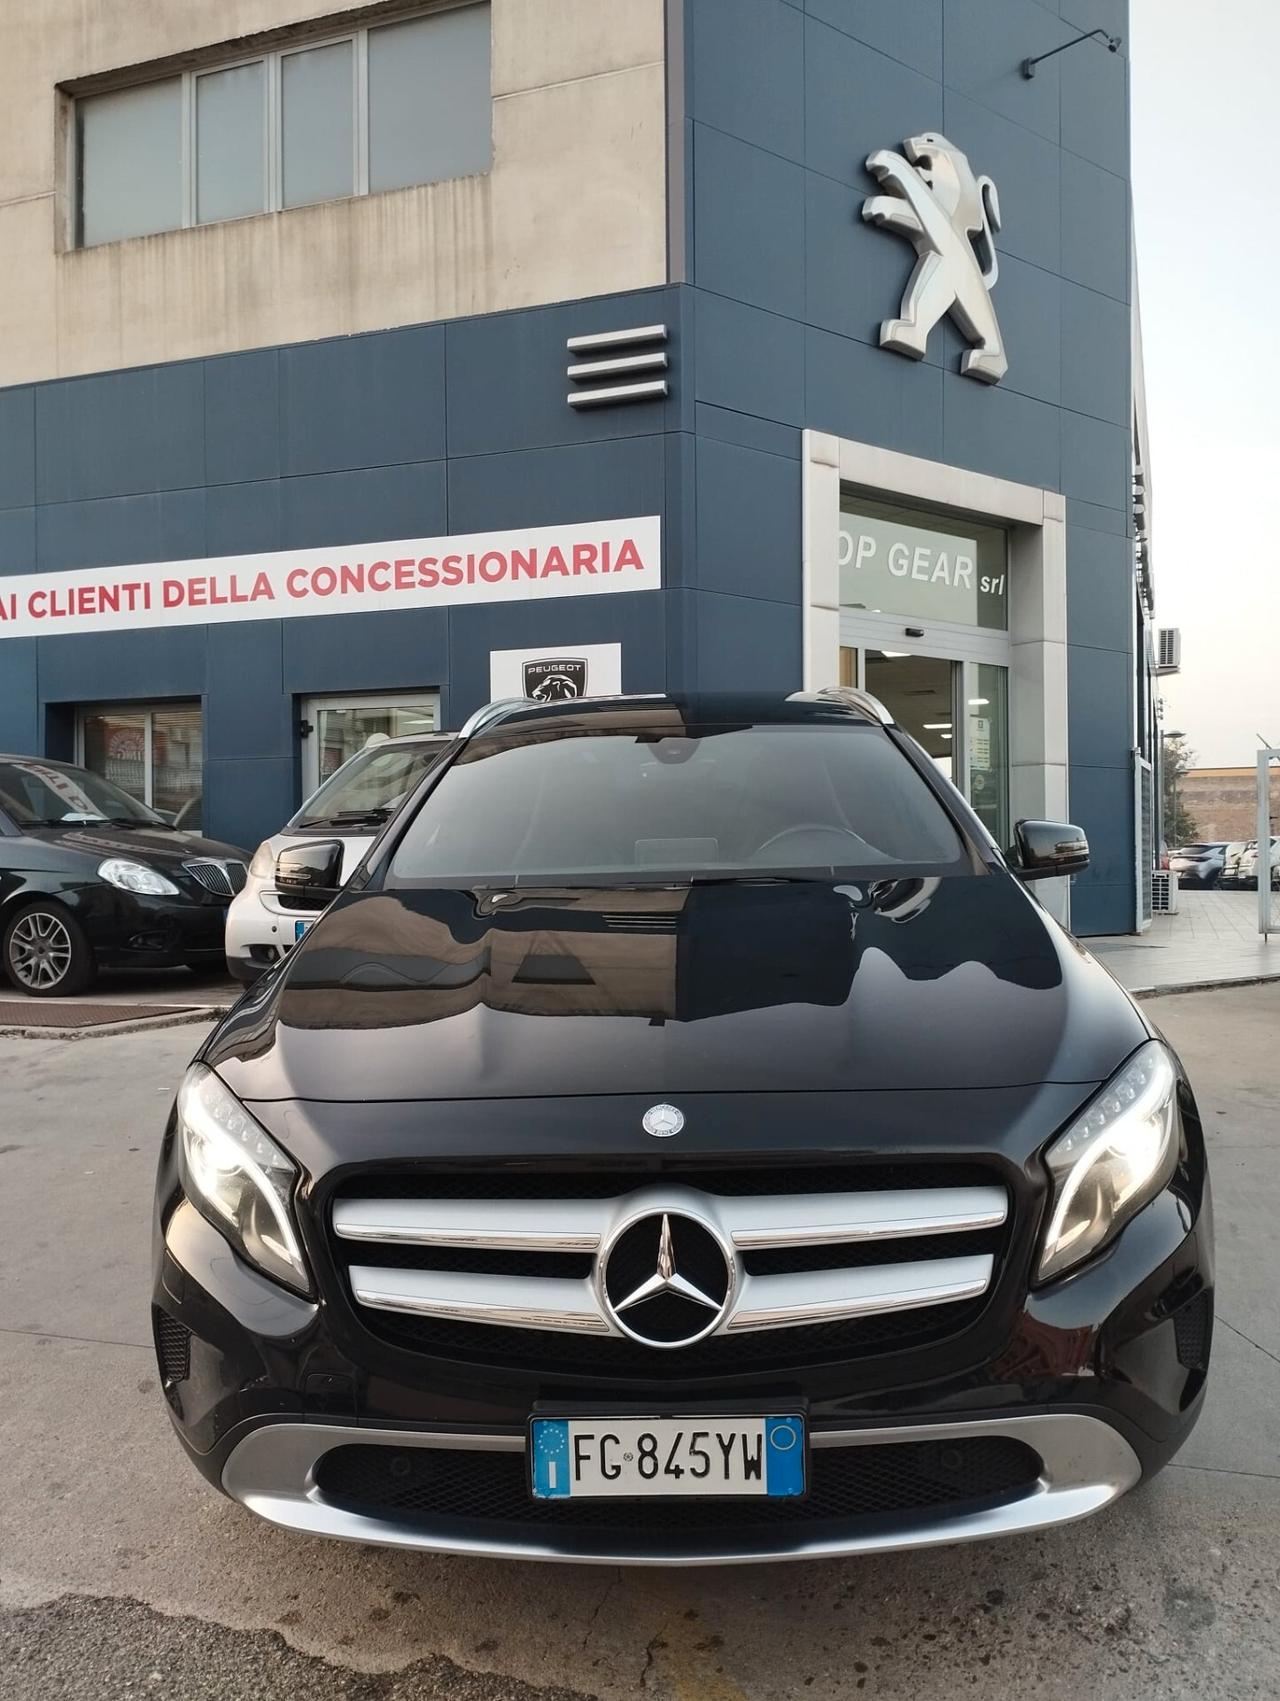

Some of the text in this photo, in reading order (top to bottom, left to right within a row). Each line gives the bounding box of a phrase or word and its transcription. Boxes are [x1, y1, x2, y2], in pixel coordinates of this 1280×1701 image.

[27, 582, 151, 619] CLIENTI
[162, 572, 276, 608] DELLA
[286, 538, 645, 599] CONCESSIONARIA
[888, 542, 972, 589] GEAR
[980, 574, 1005, 596] srl
[527, 664, 582, 674] PEUGEOT
[573, 1431, 763, 1481] FG 845YW
